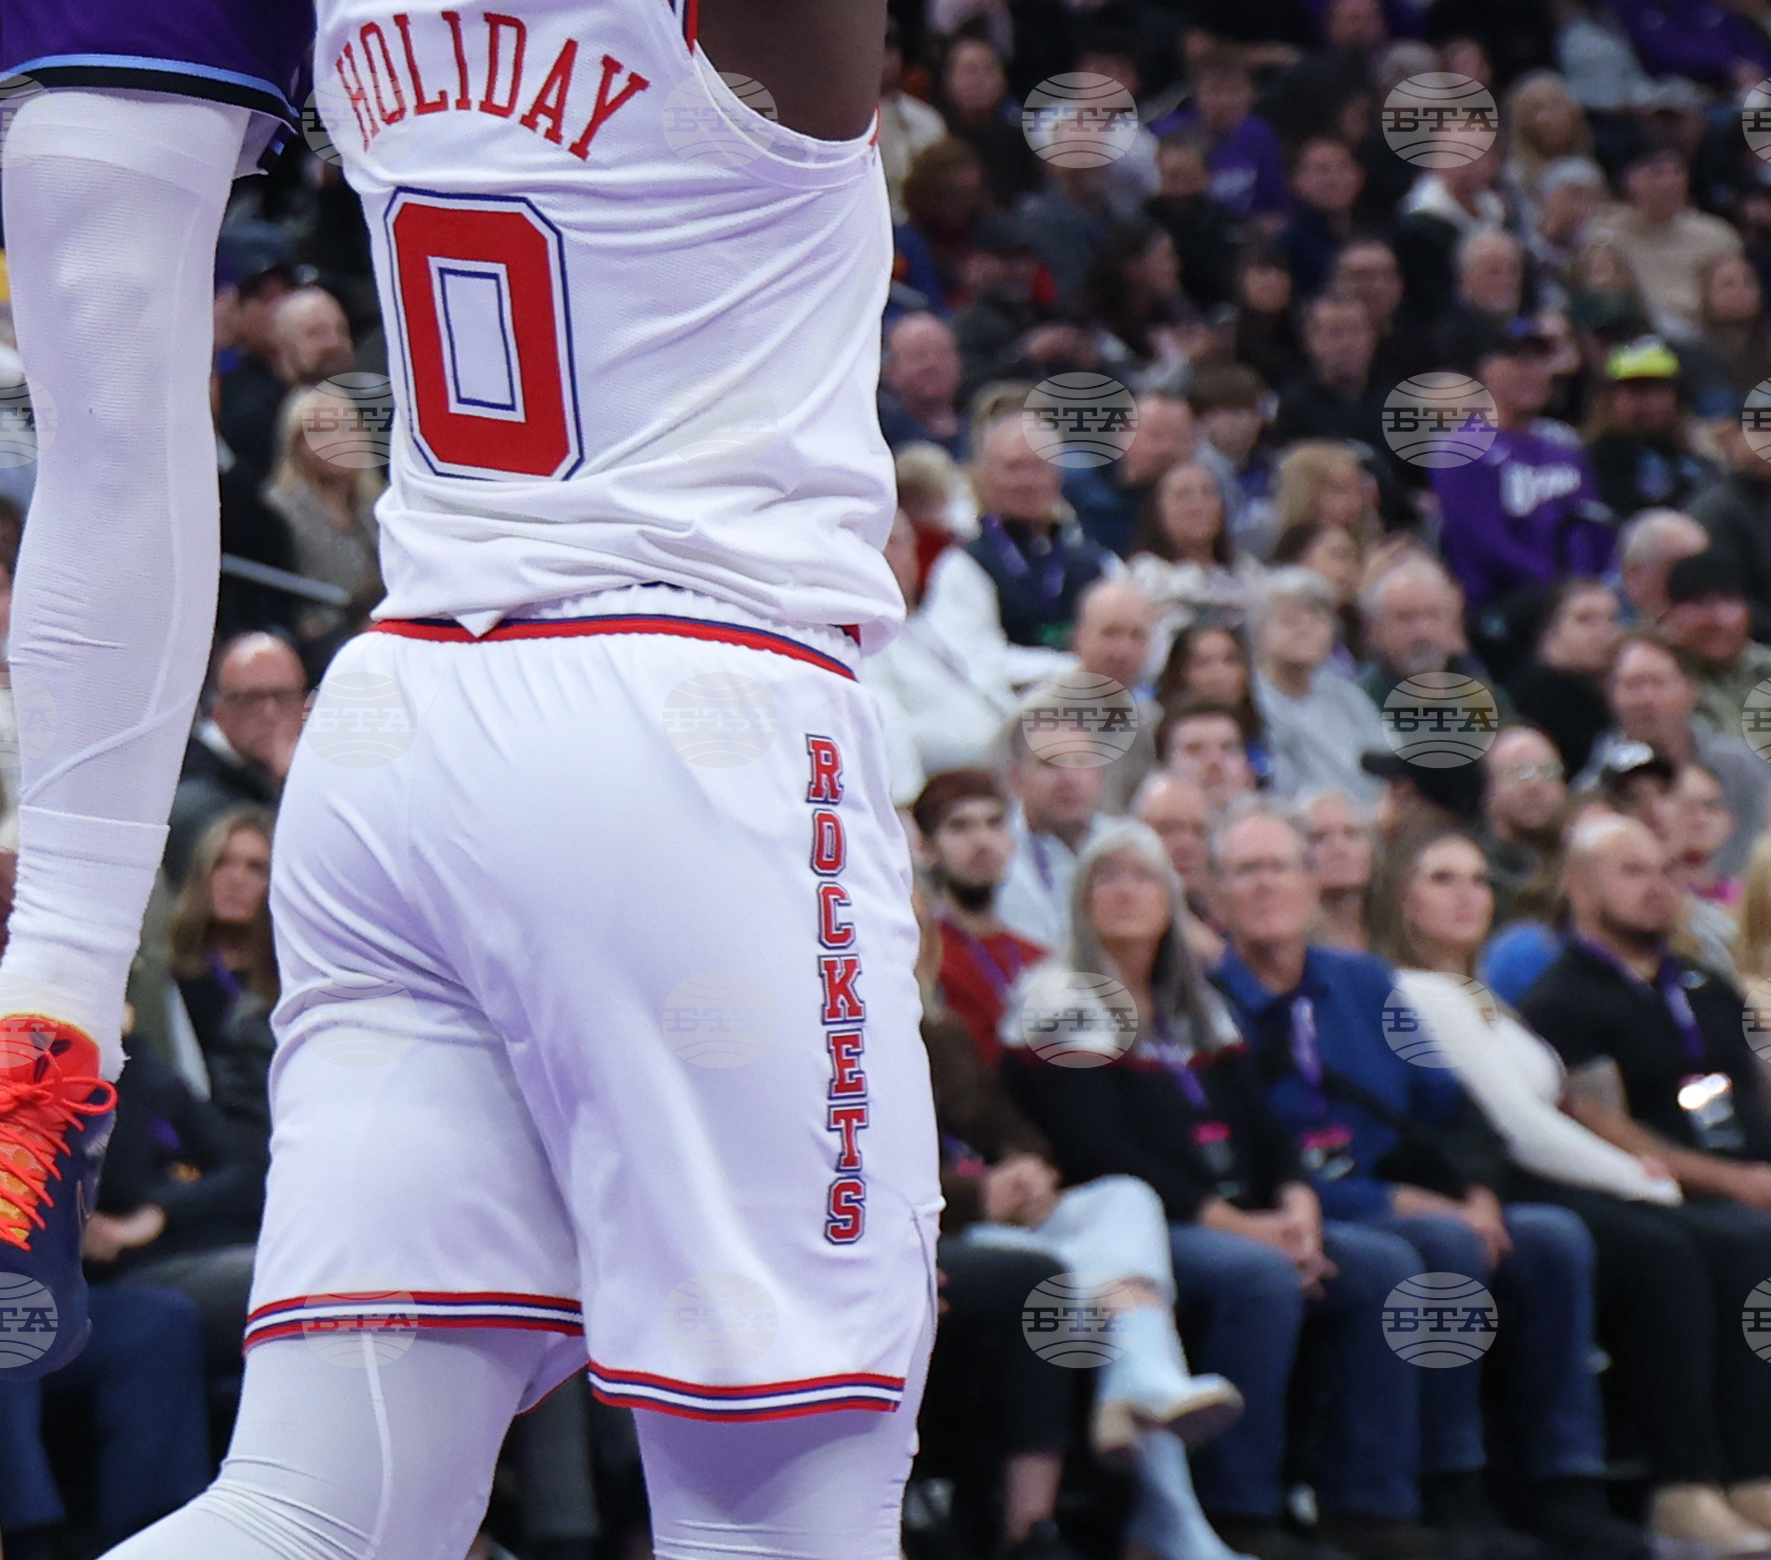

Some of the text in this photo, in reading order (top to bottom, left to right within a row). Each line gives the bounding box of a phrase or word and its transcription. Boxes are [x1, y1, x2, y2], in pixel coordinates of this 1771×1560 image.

[335, 10, 651, 162] HOLIDAY
[383, 185, 584, 482] 0
[805, 733, 868, 1247] ROCKETS
